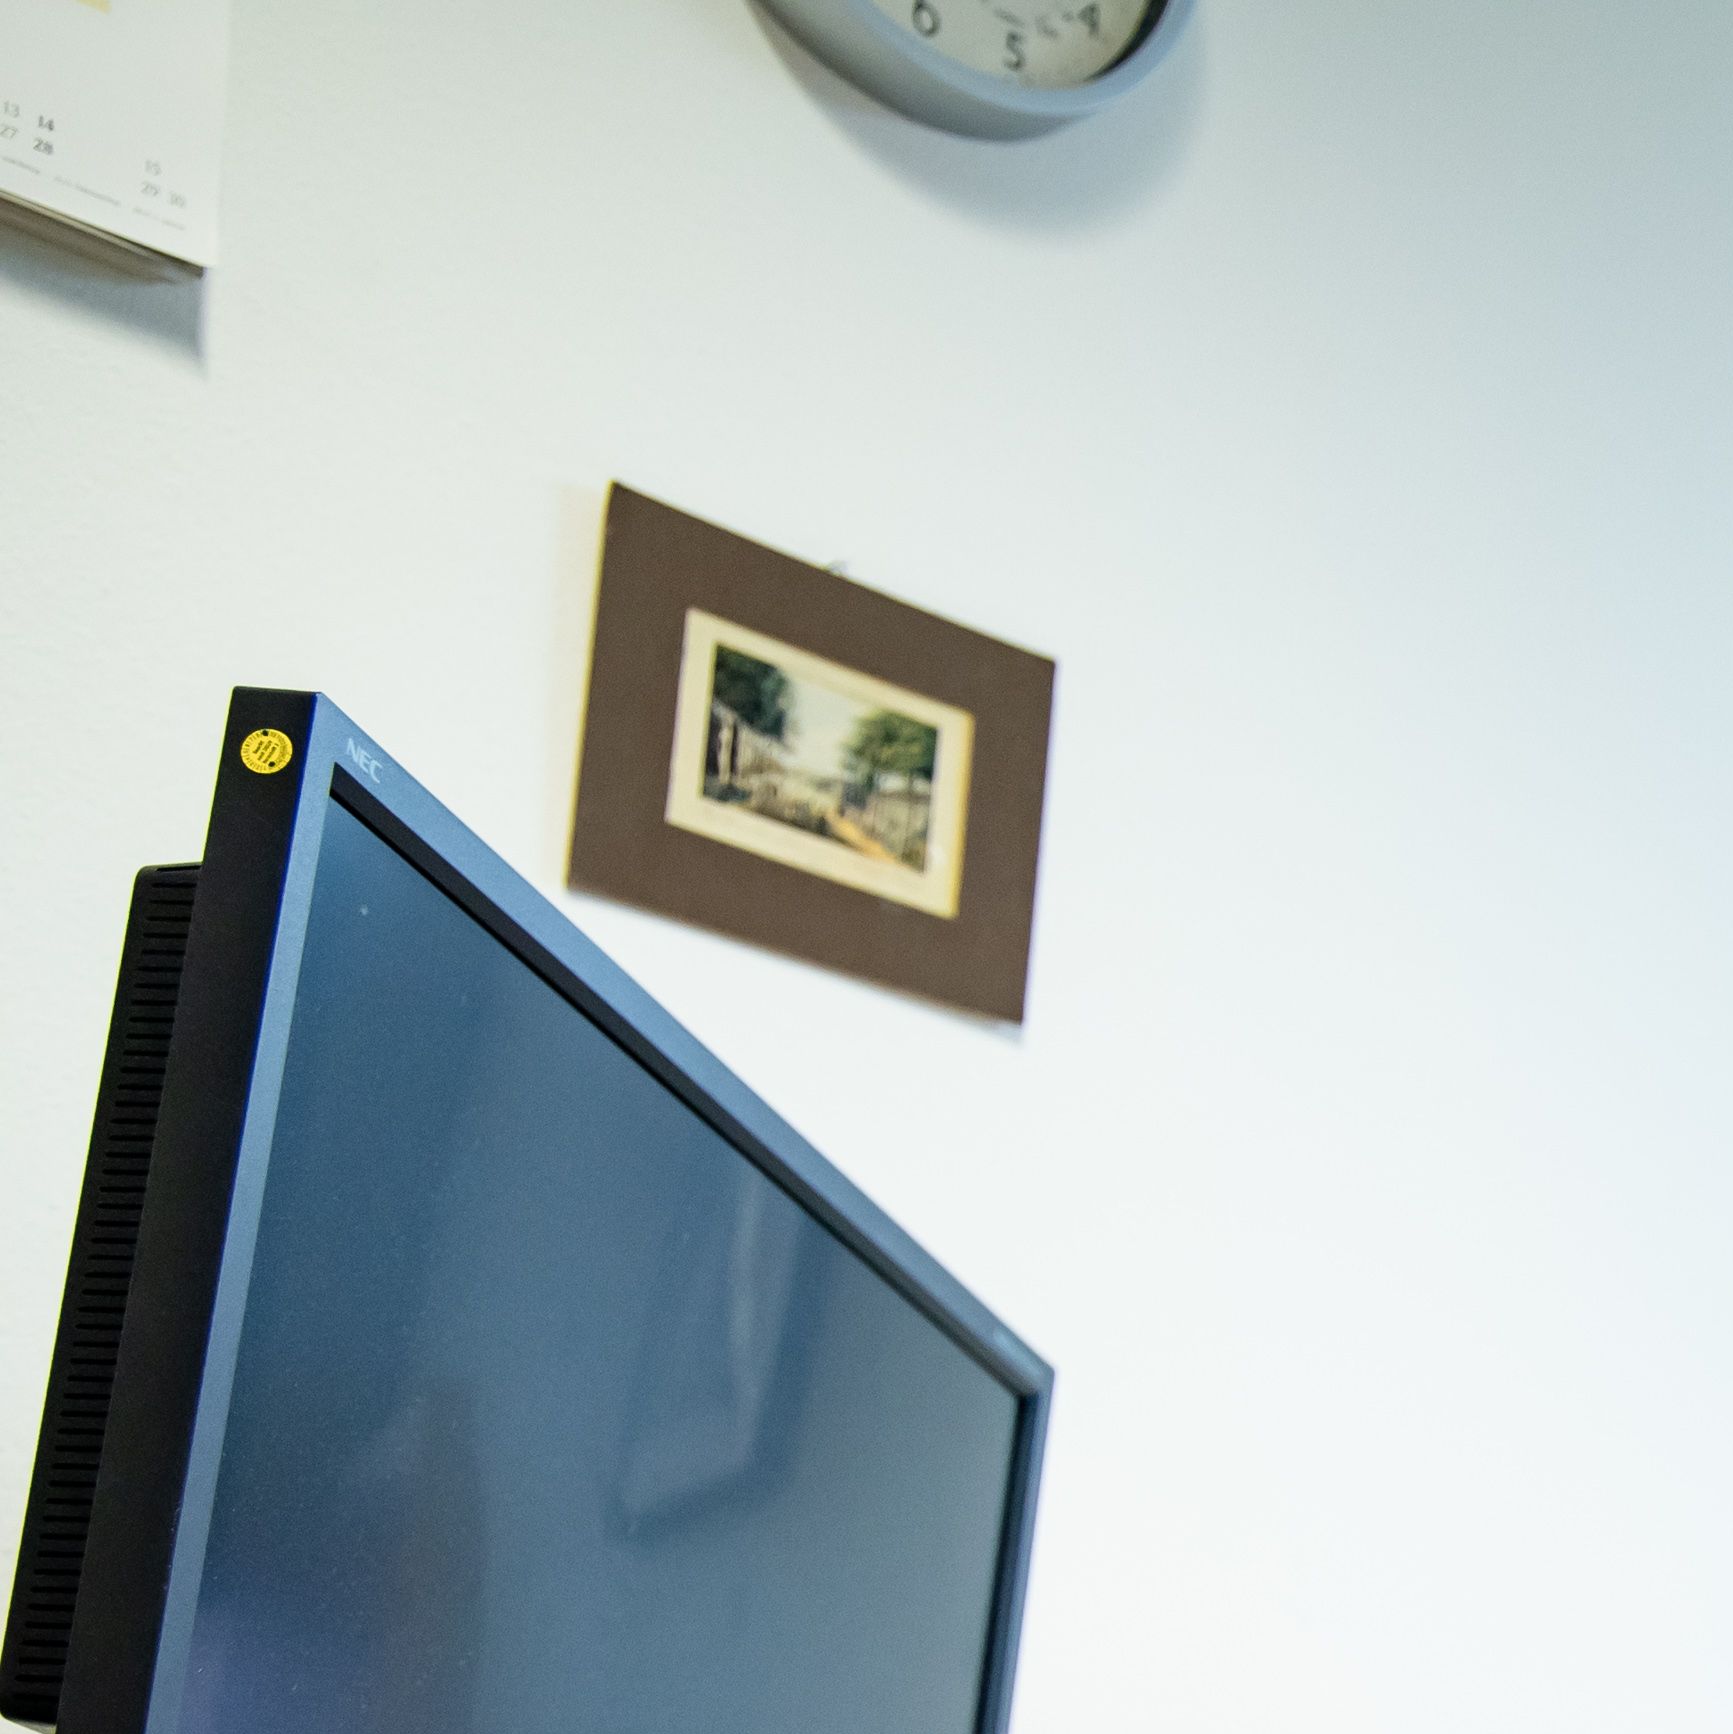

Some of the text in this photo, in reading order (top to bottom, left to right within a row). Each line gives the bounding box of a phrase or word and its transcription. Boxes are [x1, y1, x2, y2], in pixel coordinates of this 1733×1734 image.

[1003, 31, 1027, 72] 5
[38, 115, 55, 132] 14
[346, 738, 383, 784] NEC
